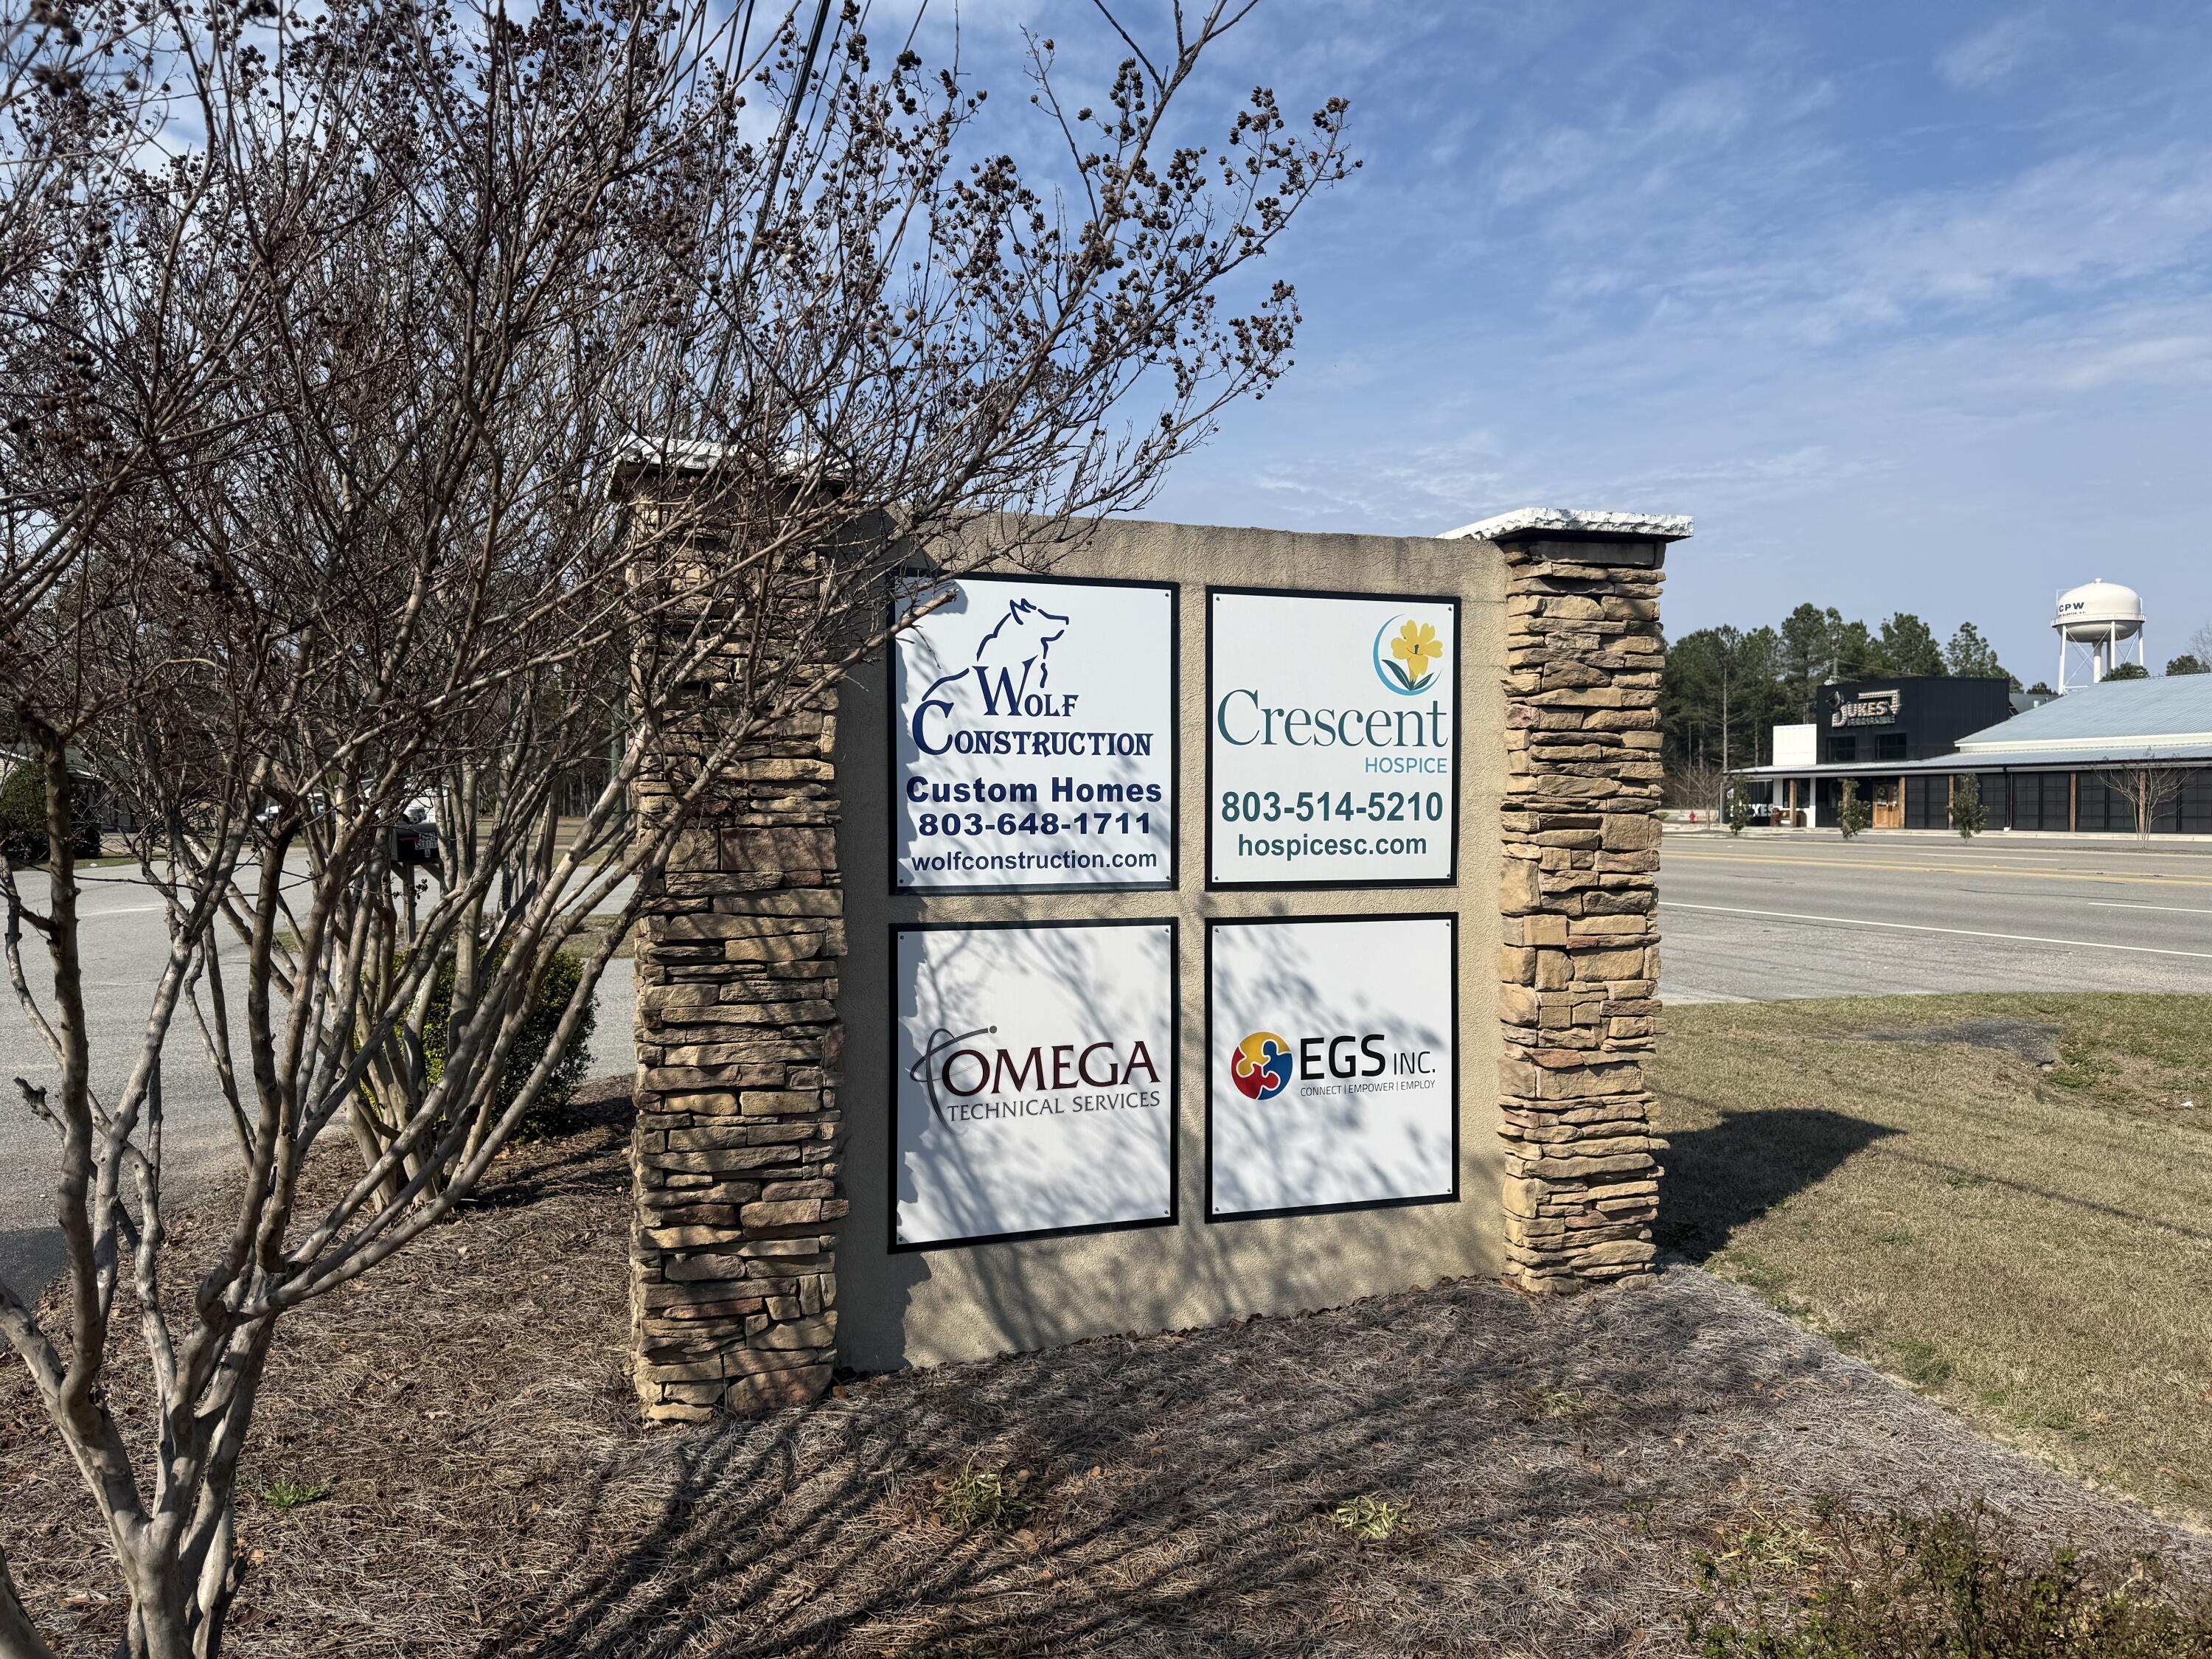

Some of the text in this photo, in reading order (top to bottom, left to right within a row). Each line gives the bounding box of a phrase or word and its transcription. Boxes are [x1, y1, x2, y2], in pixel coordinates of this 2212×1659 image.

[2059, 602, 2084, 613] CPW
[972, 655, 1079, 717] WOLF
[1217, 689, 1448, 748] Crescent
[1832, 701, 1888, 728] DUKES
[912, 700, 1153, 757] CONSTRUCTION
[1366, 757, 1447, 773] HOSPICE
[907, 776, 1162, 802] Custom Homes
[1222, 791, 1443, 822] 803-514-5210
[919, 813, 1150, 836] 803-648-1711
[911, 851, 1157, 871] wolfconstruction.com
[1238, 834, 1427, 861] hospicesc.com
[942, 1040, 1161, 1097] OMEGA
[1300, 1034, 1436, 1080] EGS INC.
[1301, 1079, 1436, 1096] CONNECT EMPOWER EMPLOY
[947, 1091, 1161, 1121] TECHNICAL SERVICES
